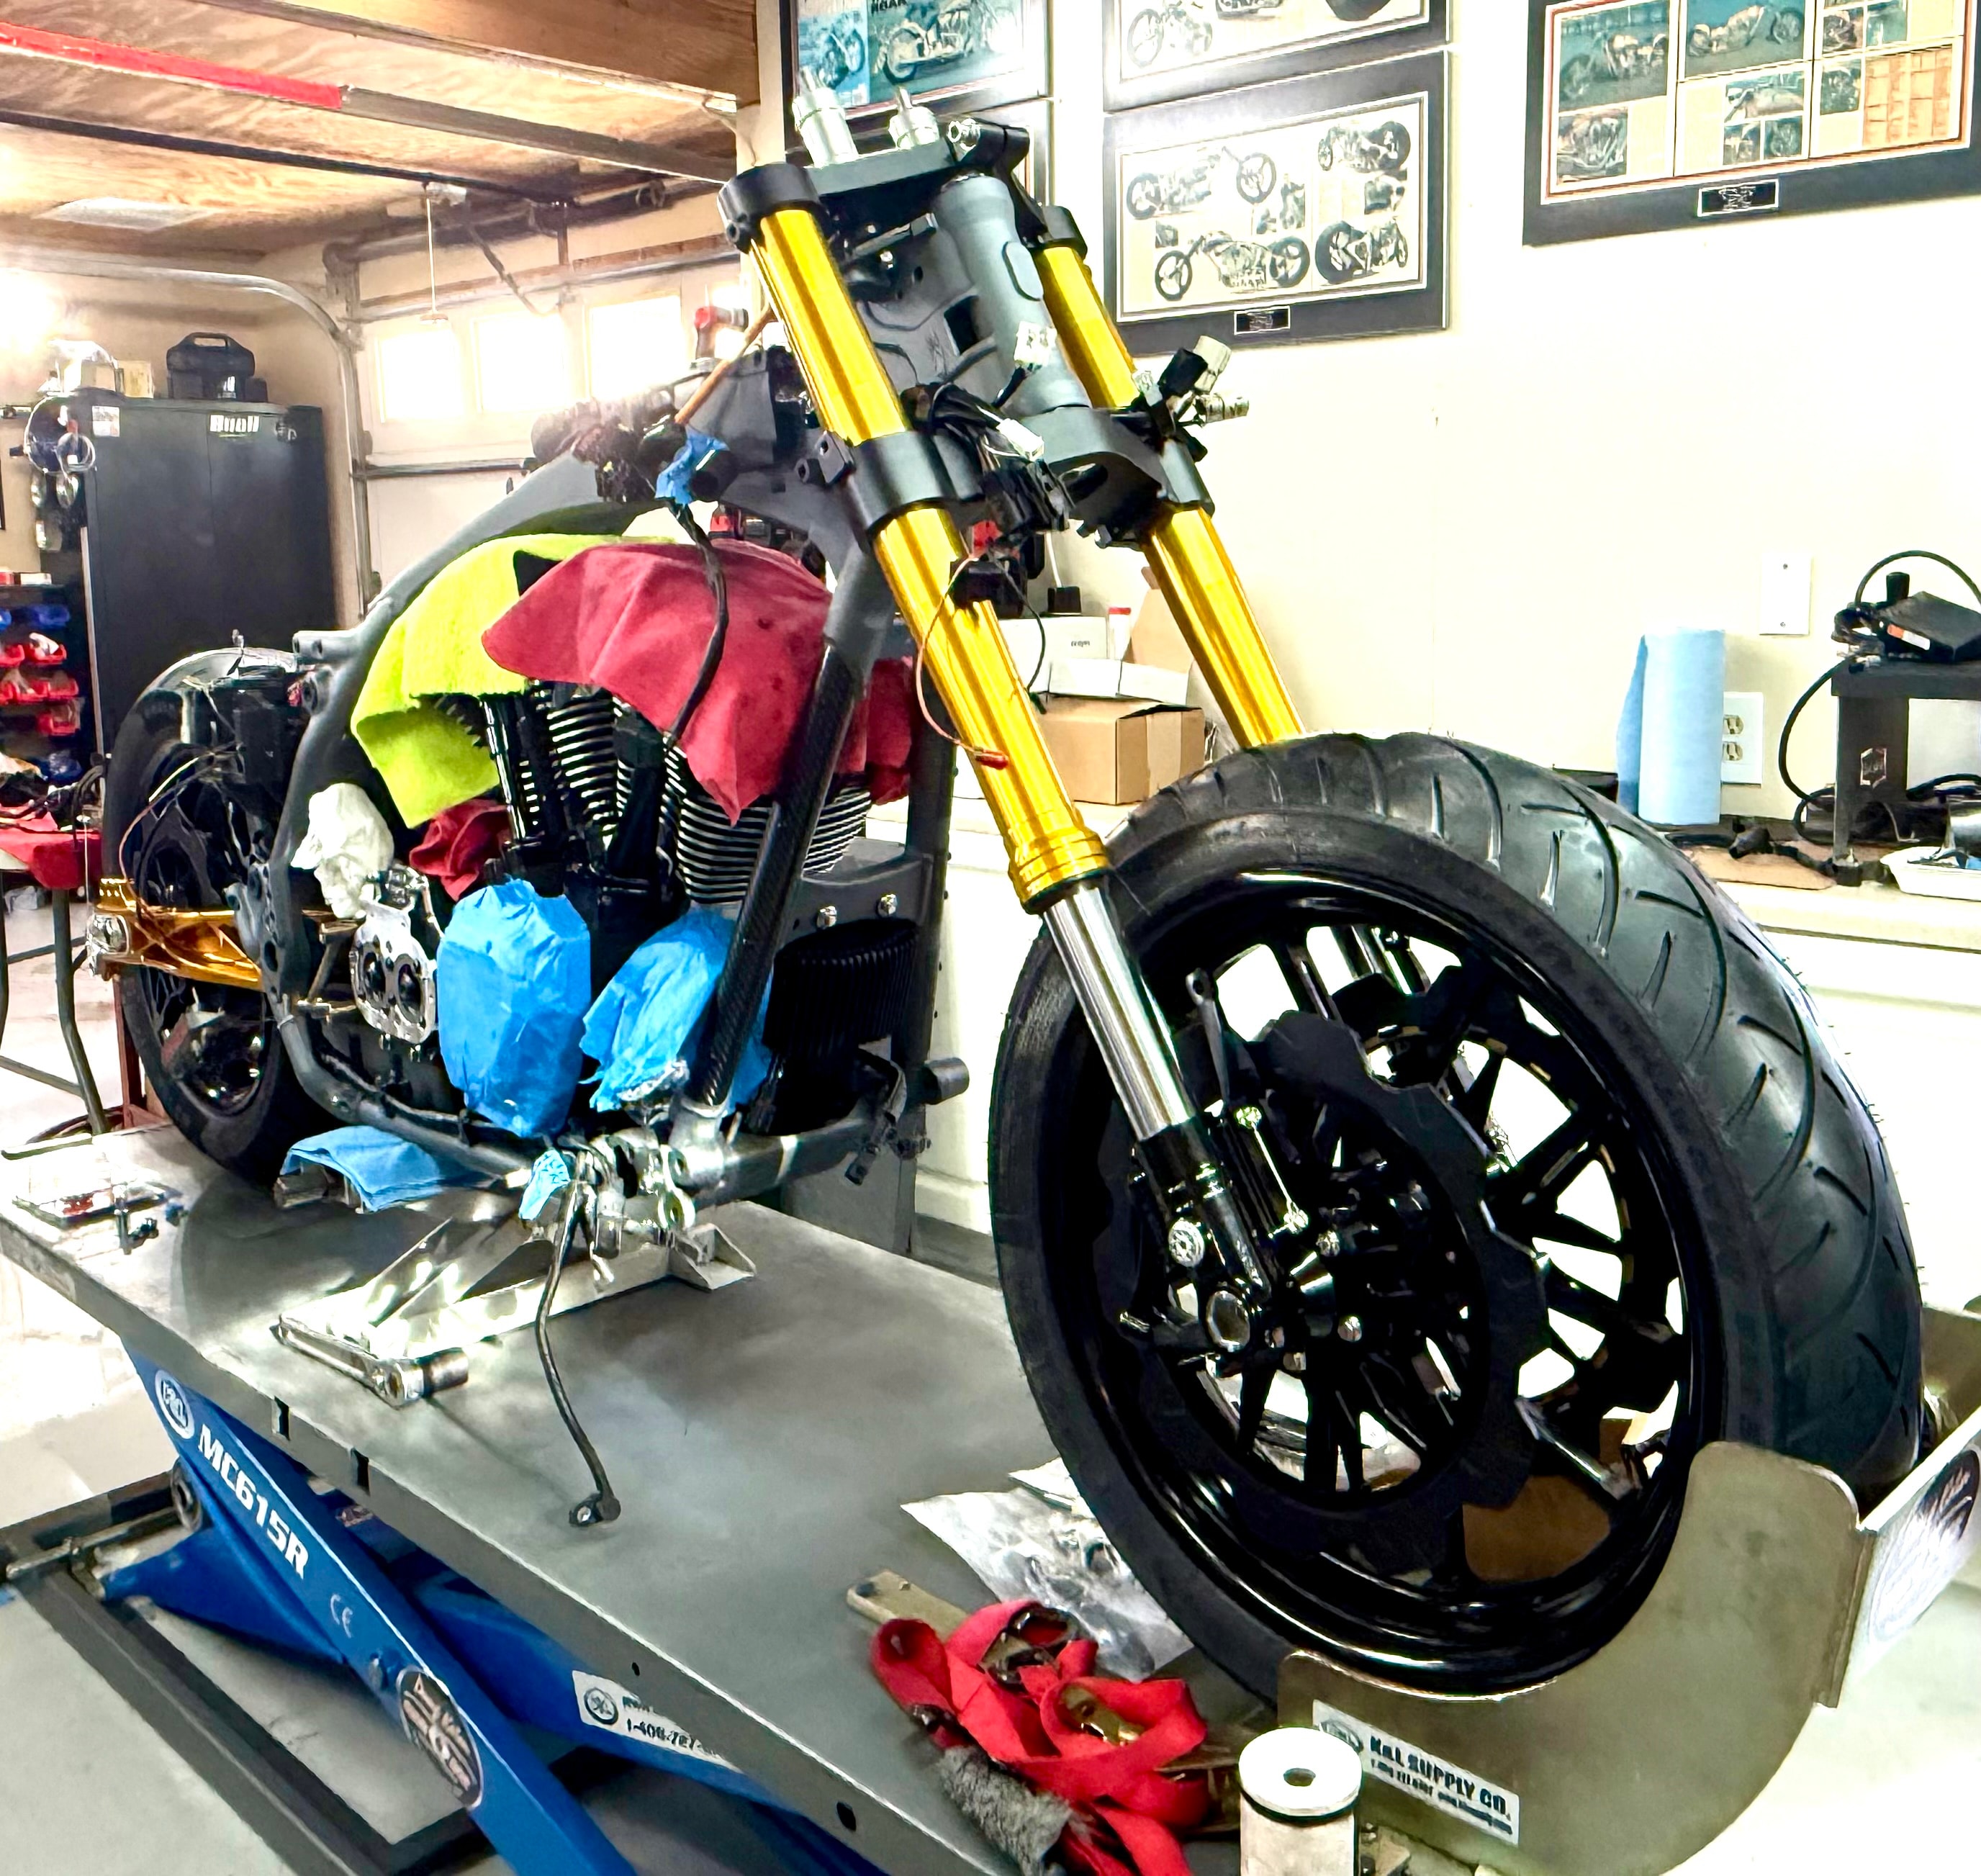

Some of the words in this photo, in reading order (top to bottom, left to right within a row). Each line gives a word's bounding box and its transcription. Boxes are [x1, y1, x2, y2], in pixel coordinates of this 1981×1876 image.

[198, 1423, 309, 1580] MC615R
[330, 1593, 353, 1638] CE
[1407, 1753, 1475, 1800] SUPPLY
